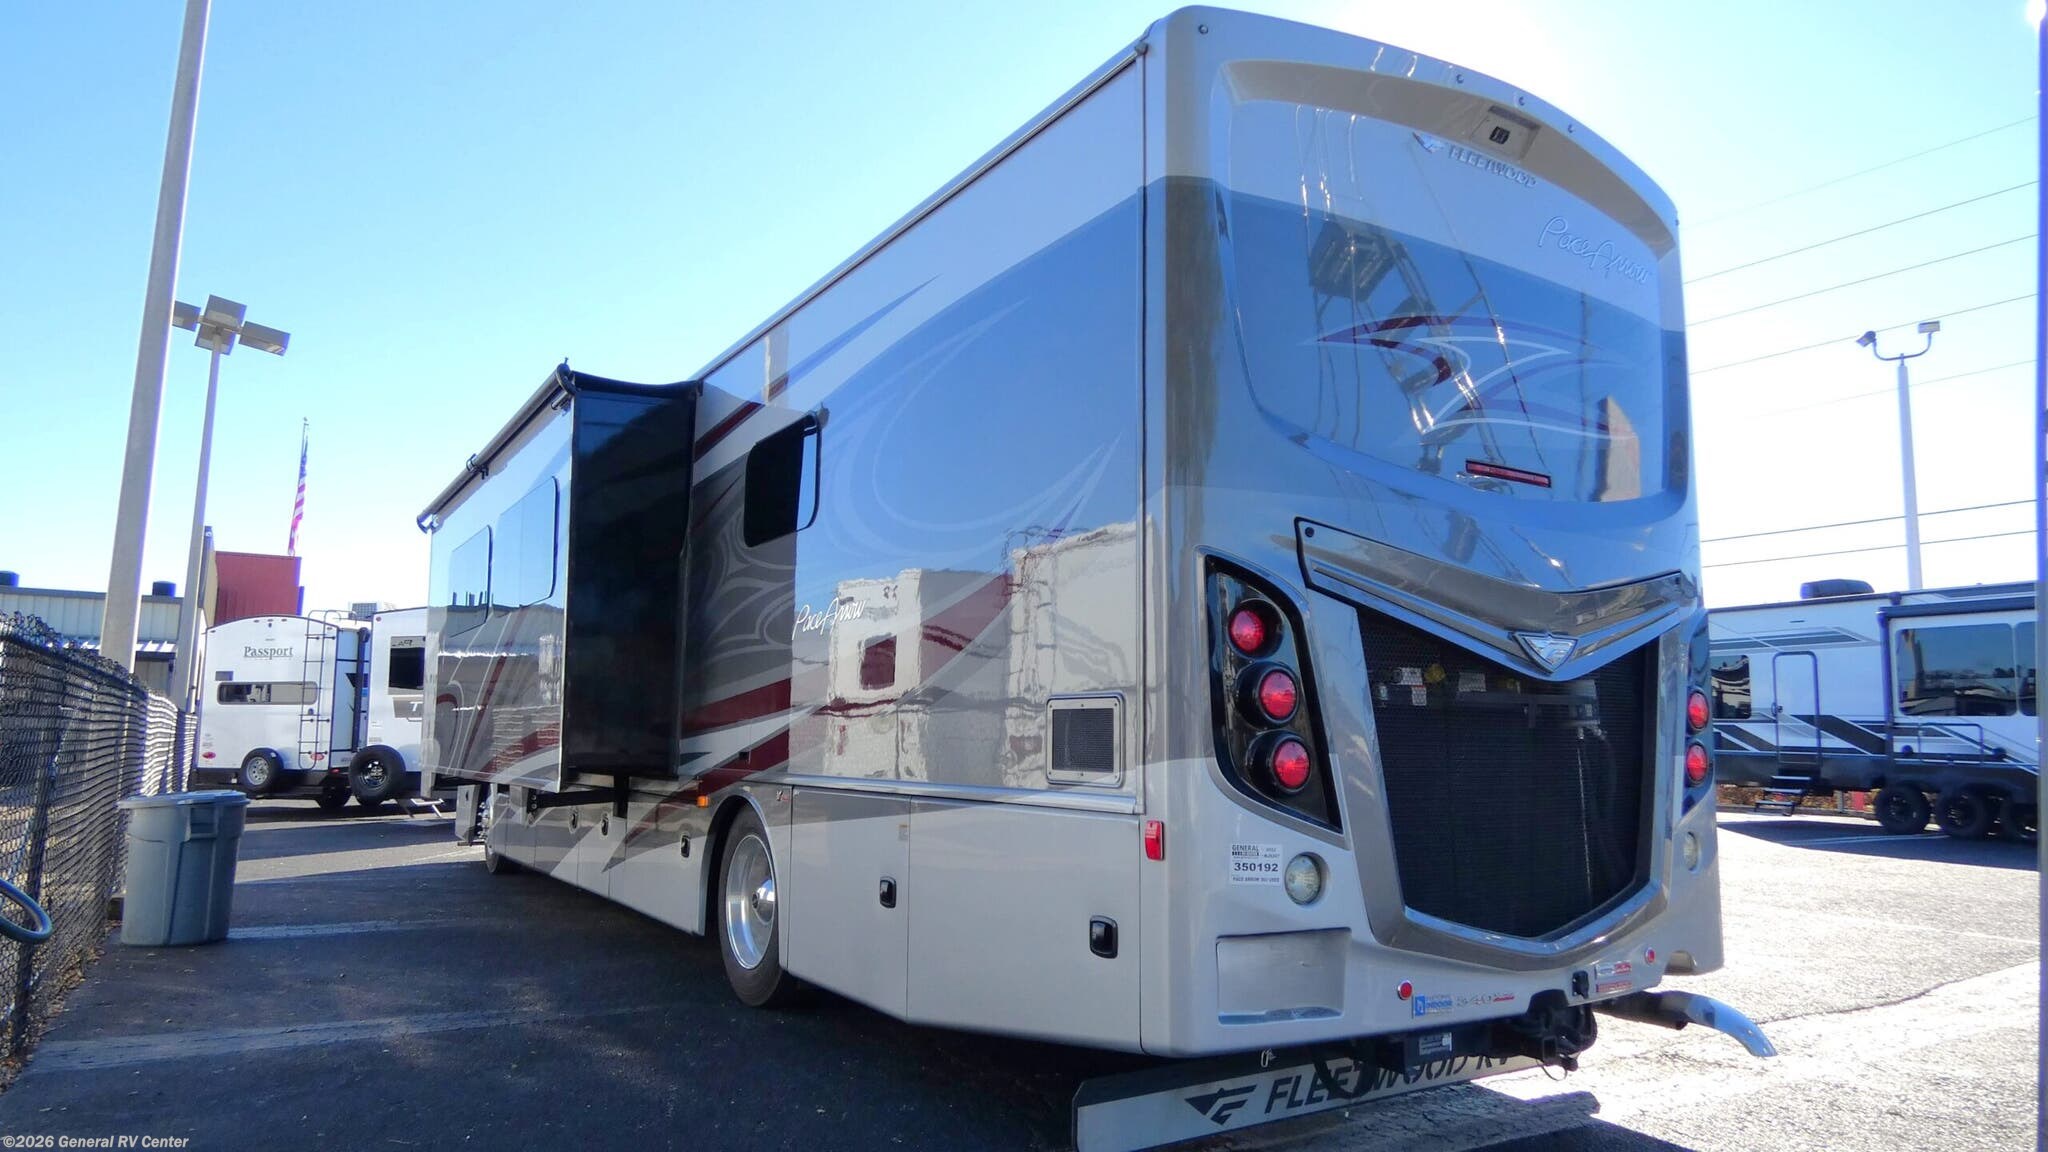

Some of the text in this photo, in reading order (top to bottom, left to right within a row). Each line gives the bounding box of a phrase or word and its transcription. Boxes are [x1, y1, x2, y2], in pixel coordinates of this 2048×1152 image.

[1449, 145, 1537, 188] FLEETWOOD
[244, 646, 293, 661] Passport
[1234, 862, 1279, 872] 350192
